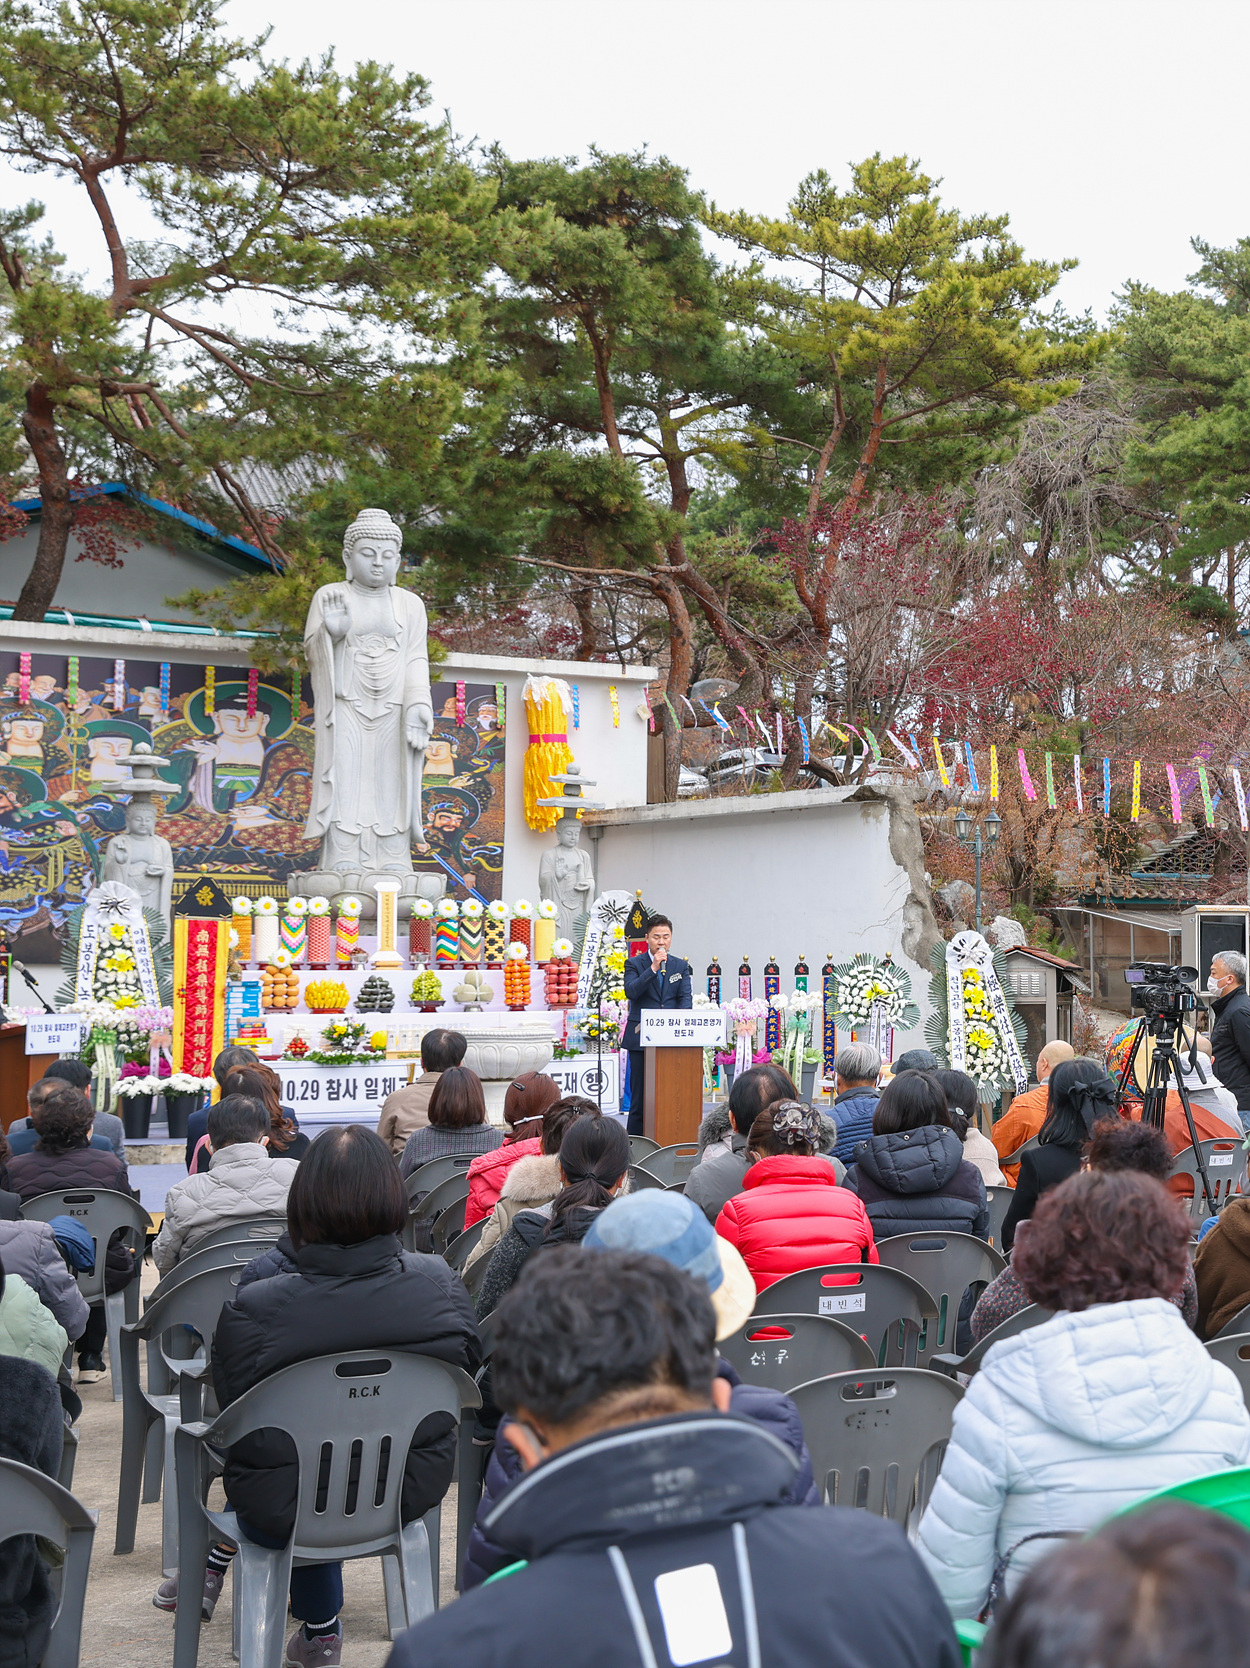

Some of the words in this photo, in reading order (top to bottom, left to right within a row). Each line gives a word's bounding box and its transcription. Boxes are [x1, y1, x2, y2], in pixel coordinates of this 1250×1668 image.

[81, 923, 96, 980] 도봉산
[132, 928, 147, 955] 이태원
[582, 932, 598, 969] 도봉구
[646, 1018, 664, 1026] 10.29
[326, 1078, 358, 1101] 참사
[348, 1384, 381, 1398] R.C.K
